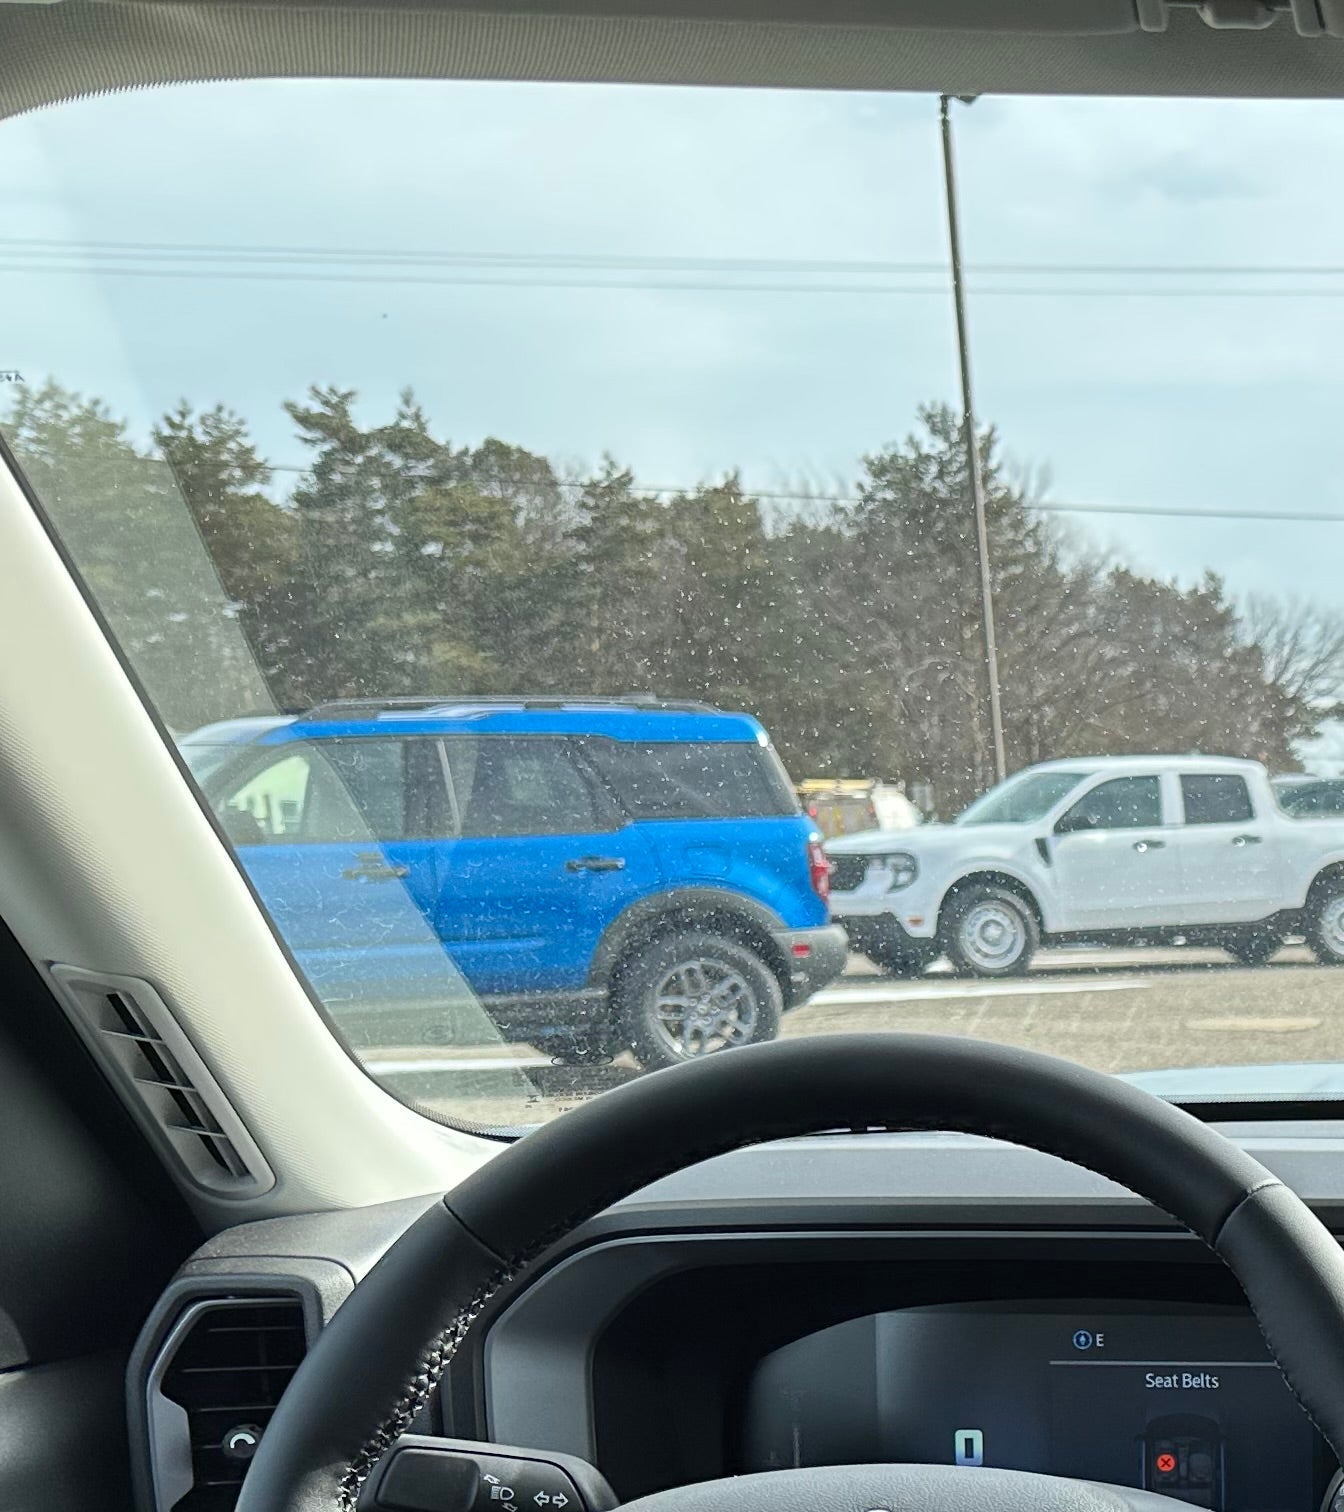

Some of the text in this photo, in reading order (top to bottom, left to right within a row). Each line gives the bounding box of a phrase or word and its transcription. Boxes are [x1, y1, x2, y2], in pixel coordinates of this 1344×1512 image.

[1096, 1333, 1104, 1347] E
[1145, 1372, 1219, 1388] Seat Belts
